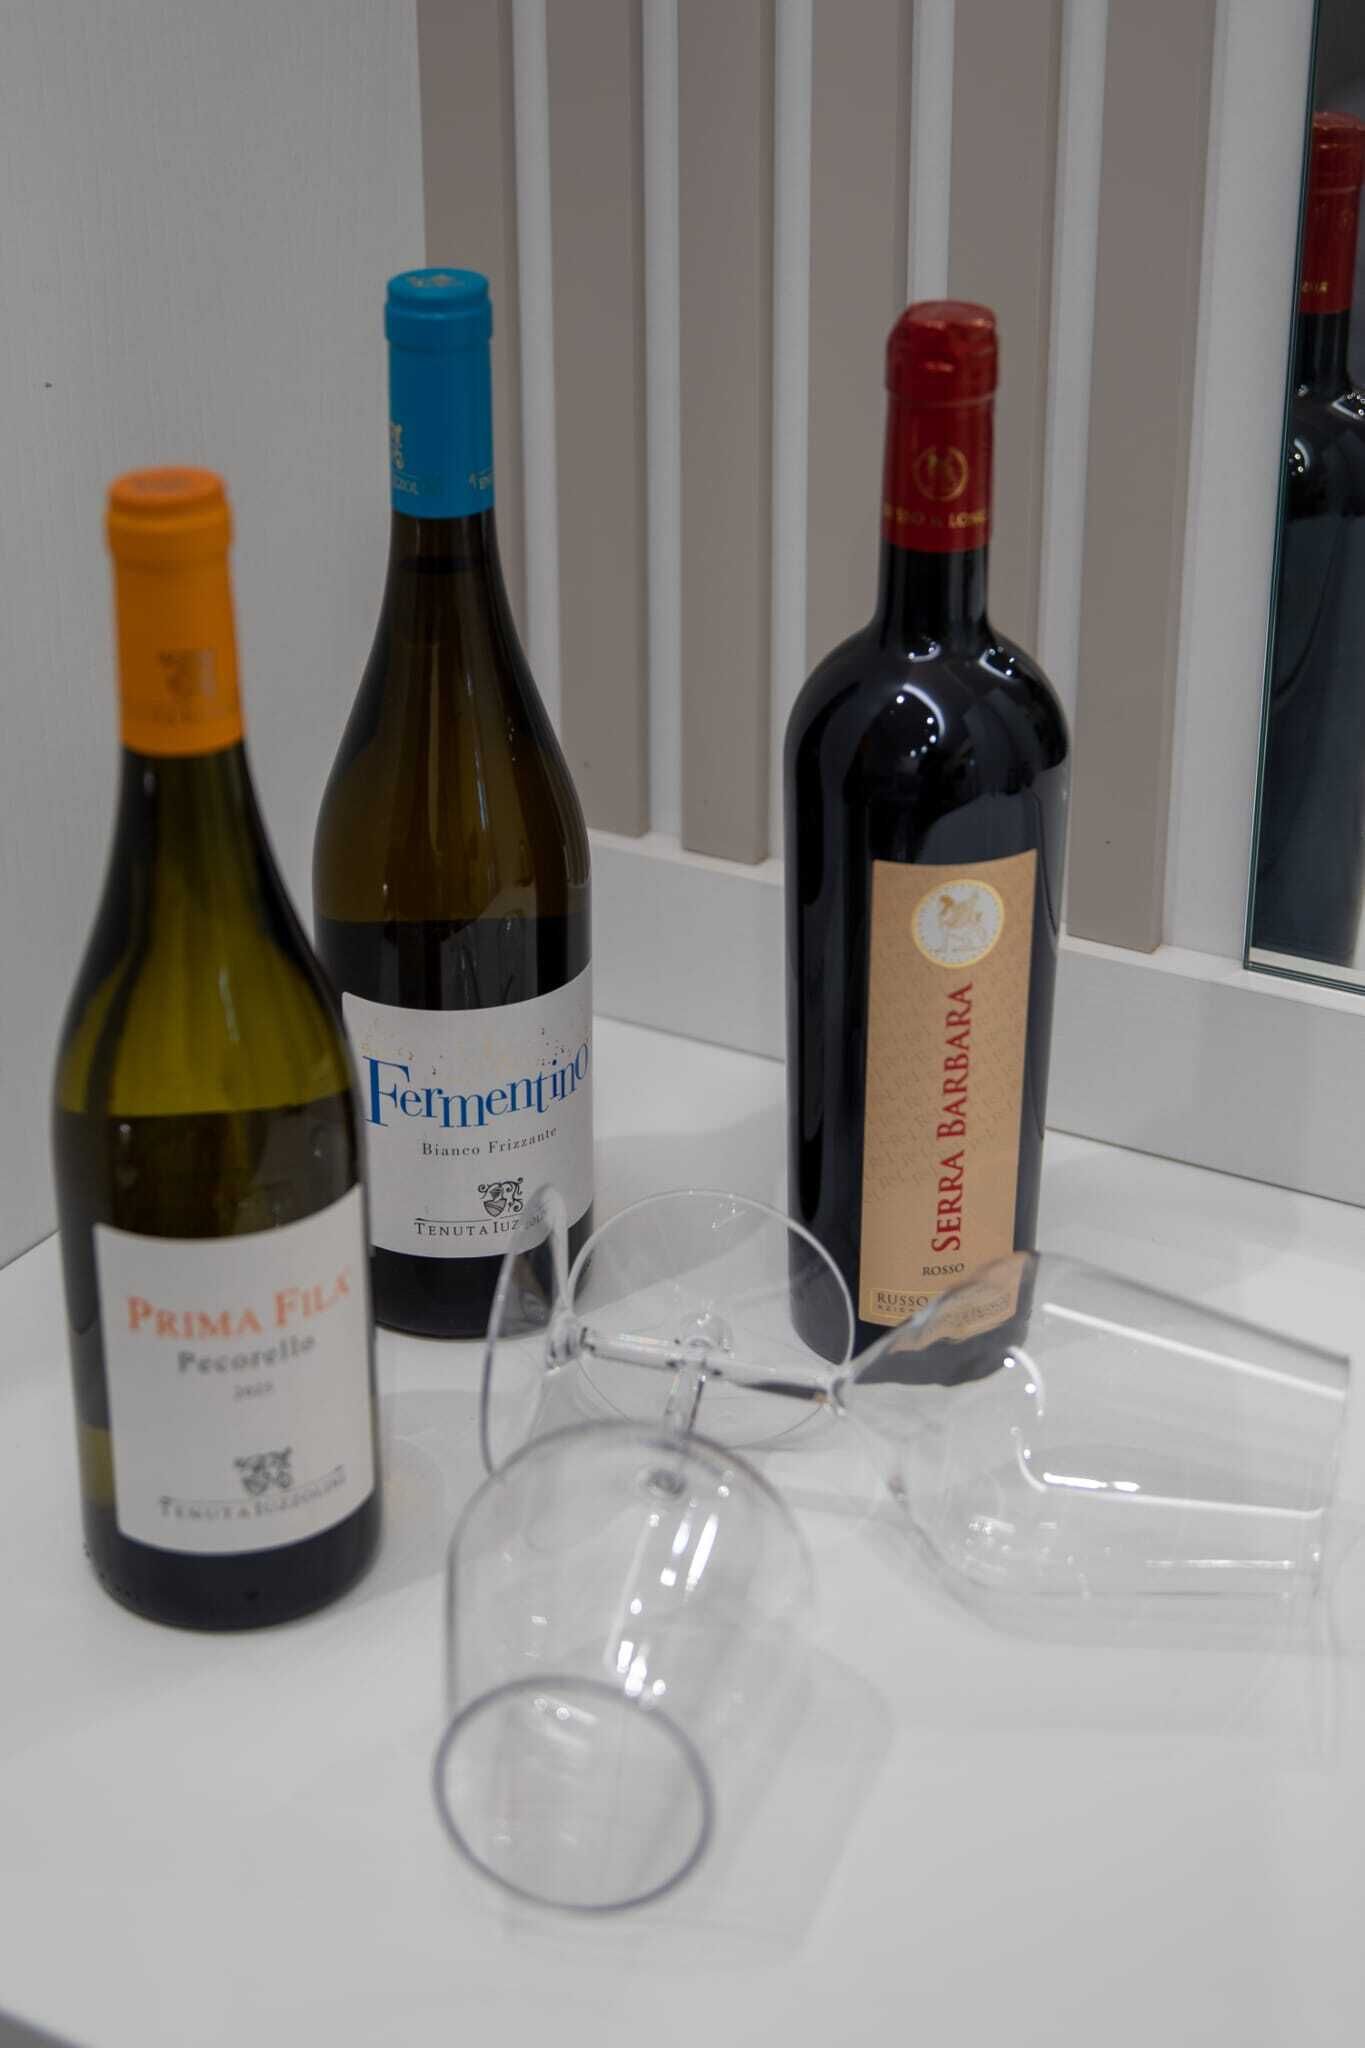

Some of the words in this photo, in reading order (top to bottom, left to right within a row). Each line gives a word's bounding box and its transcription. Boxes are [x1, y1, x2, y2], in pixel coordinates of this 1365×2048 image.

[936, 981, 973, 1141] BARBARA
[362, 1043, 591, 1128] Fermentino
[422, 1142, 480, 1156] Bianco
[488, 1128, 557, 1154] Frizzante
[930, 1150, 965, 1252] SERRA
[414, 1221, 488, 1236] TENUTA
[921, 1262, 965, 1276] ROSSO
[126, 1296, 263, 1339] PRIMA
[876, 1292, 929, 1307] RUSSO
[177, 1334, 315, 1374] Pecorello
